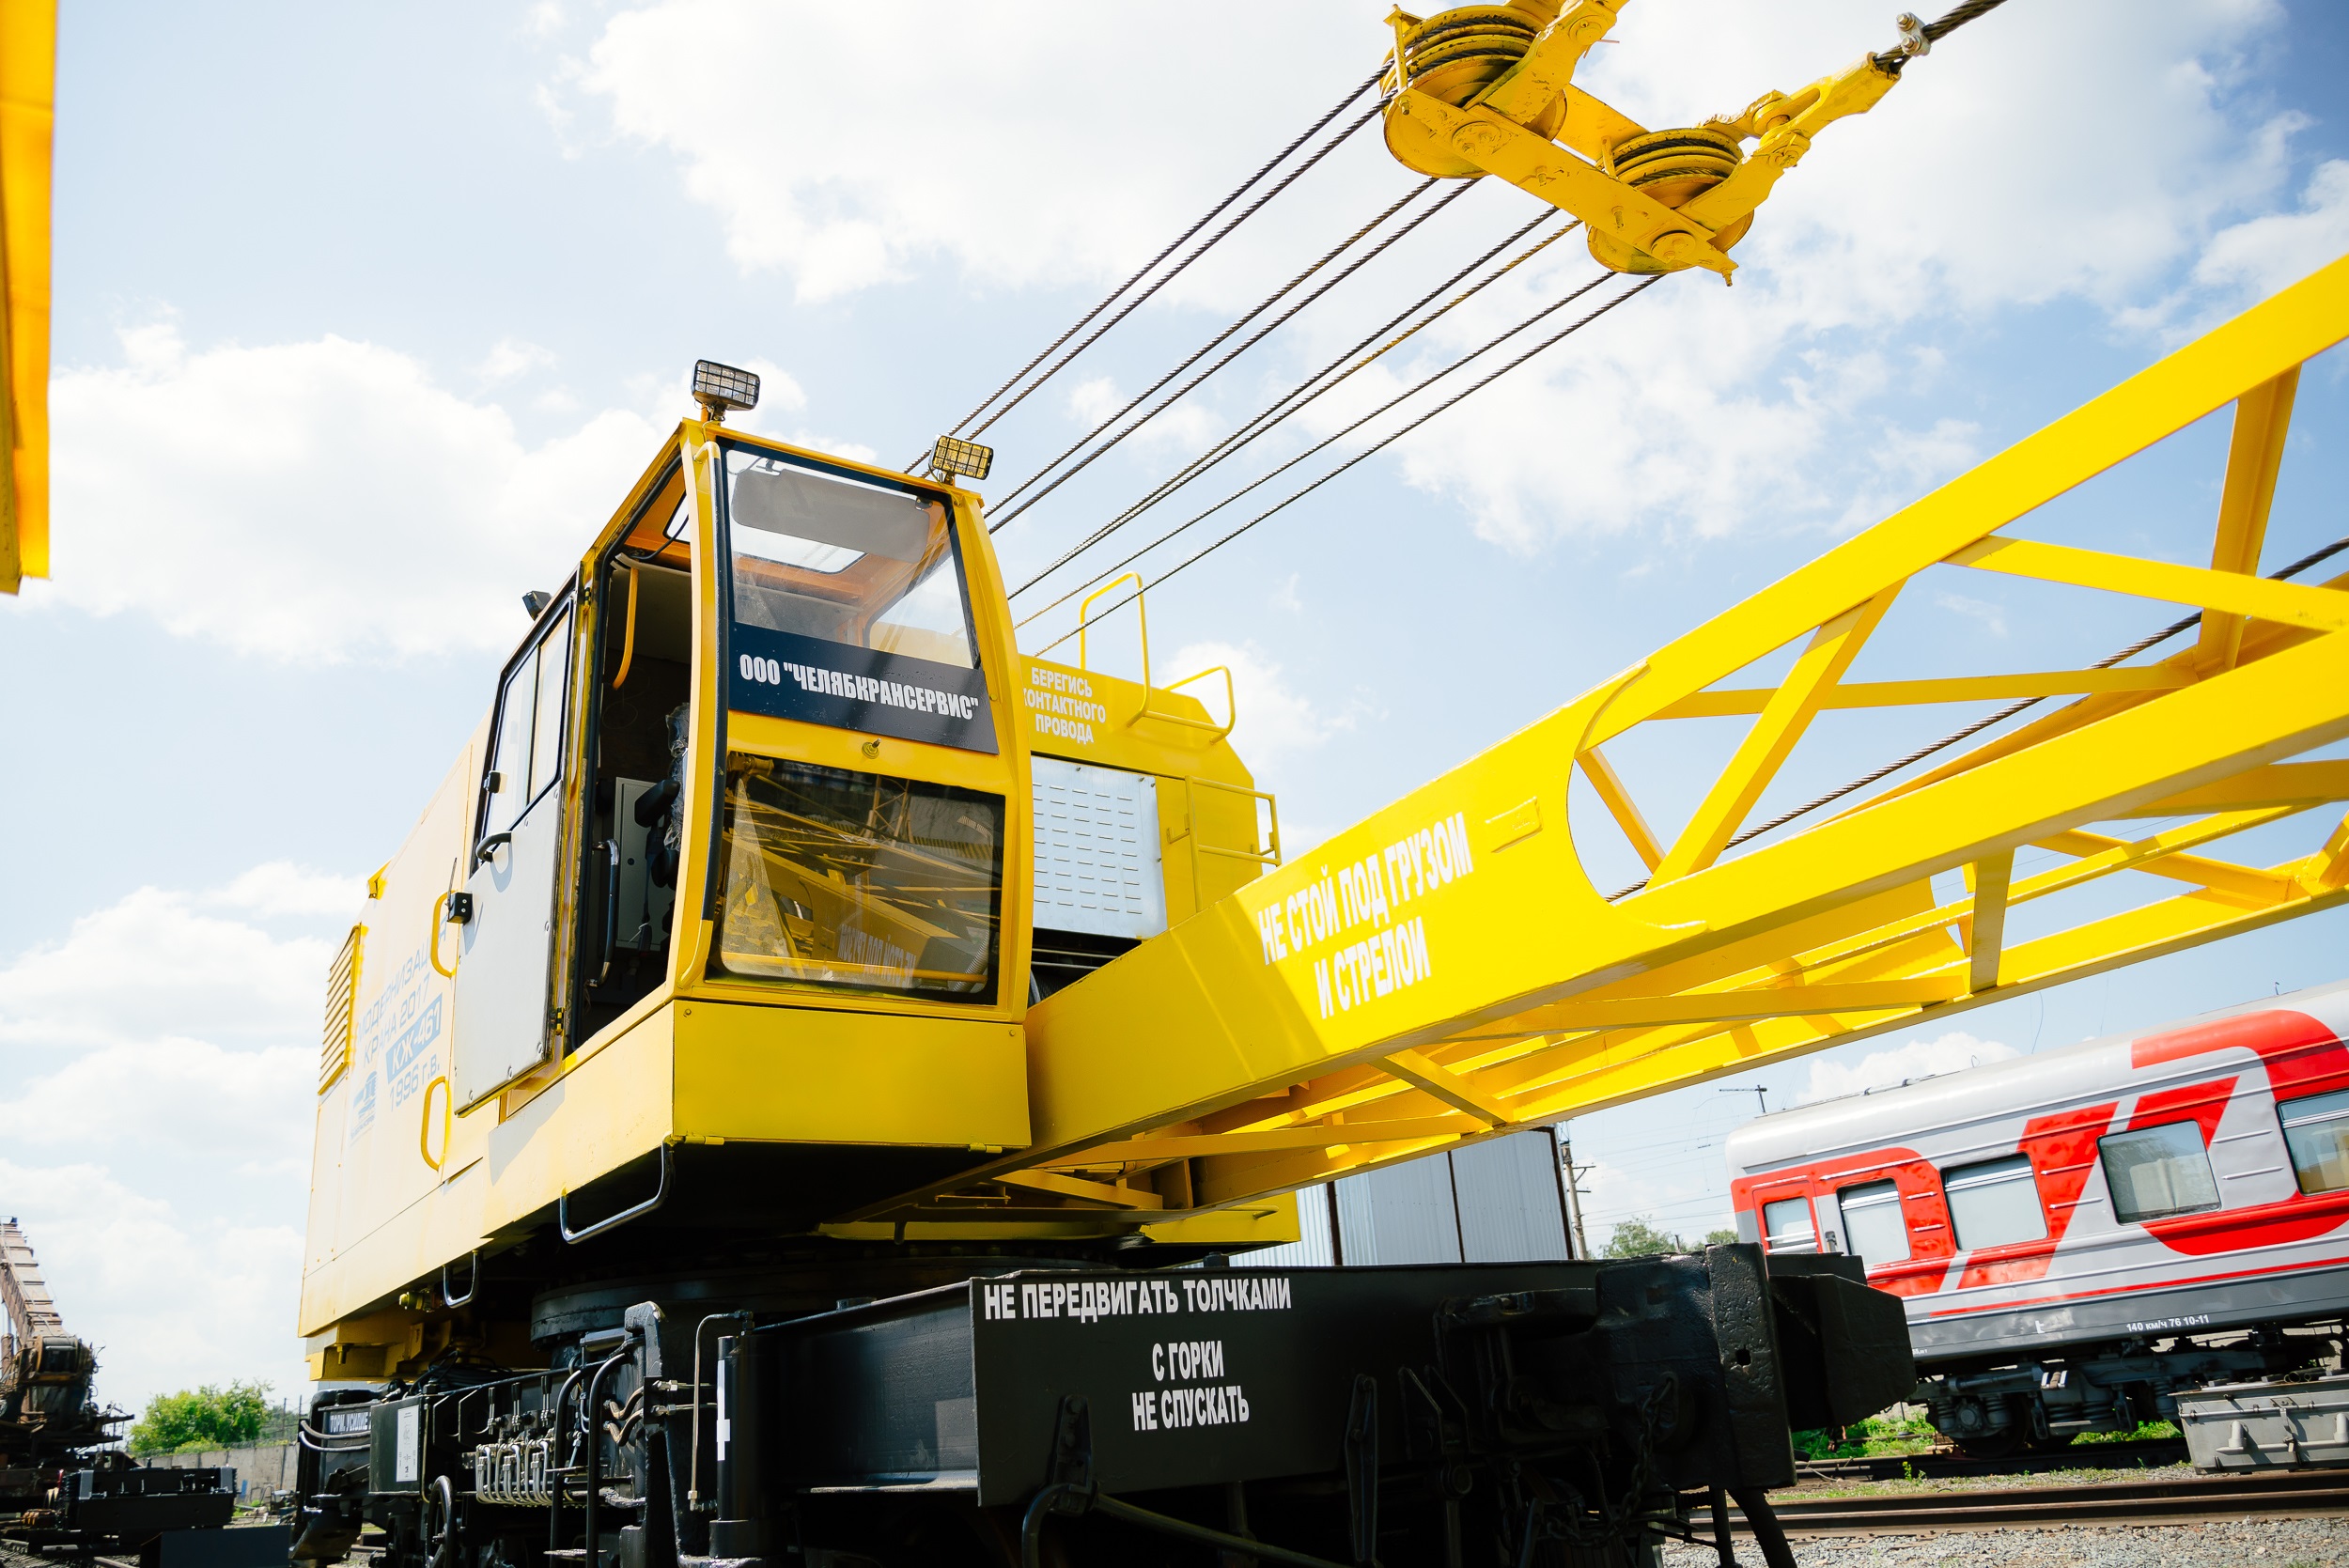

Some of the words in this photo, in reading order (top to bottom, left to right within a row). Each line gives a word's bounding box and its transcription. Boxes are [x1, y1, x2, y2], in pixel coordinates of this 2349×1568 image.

[739, 653, 781, 686] ООО
[783, 660, 979, 721] "ЧЕЛЯБКРАНСЕРВИС"
[1031, 666, 1093, 698] БЕРЕГИСЬ
[1034, 713, 1095, 745] ПРОВОДА
[1257, 902, 1288, 966] НЕ
[1286, 863, 1341, 953] СТОЙ
[1338, 853, 1391, 929] ПОД
[1383, 811, 1474, 908] ГРУЗОМ
[357, 914, 448, 1042] МОДЕРНИЗАЦЯ
[1314, 957, 1334, 1020] И
[363, 1011, 397, 1069] КРАНА
[399, 971, 430, 1030] 2017
[392, 1001, 441, 1076] КЖ-461
[390, 1063, 419, 1113] 1996
[984, 1284, 1016, 1320] НЕ
[1022, 1281, 1179, 1324] ПЕРЕДВИГАТЬ
[1183, 1278, 1292, 1312] ТОЛЧКАМИ
[2125, 1322, 2143, 1332] 140
[2145, 1320, 2168, 1330] км/ч
[2169, 1318, 2182, 1328] 76
[2183, 1314, 2210, 1327] 10-11
[1152, 1343, 1165, 1382] С
[1168, 1340, 1224, 1380] ГОРКИ
[1132, 1391, 1158, 1432] НЕ
[1160, 1385, 1250, 1429] СПУСКАТЬ
